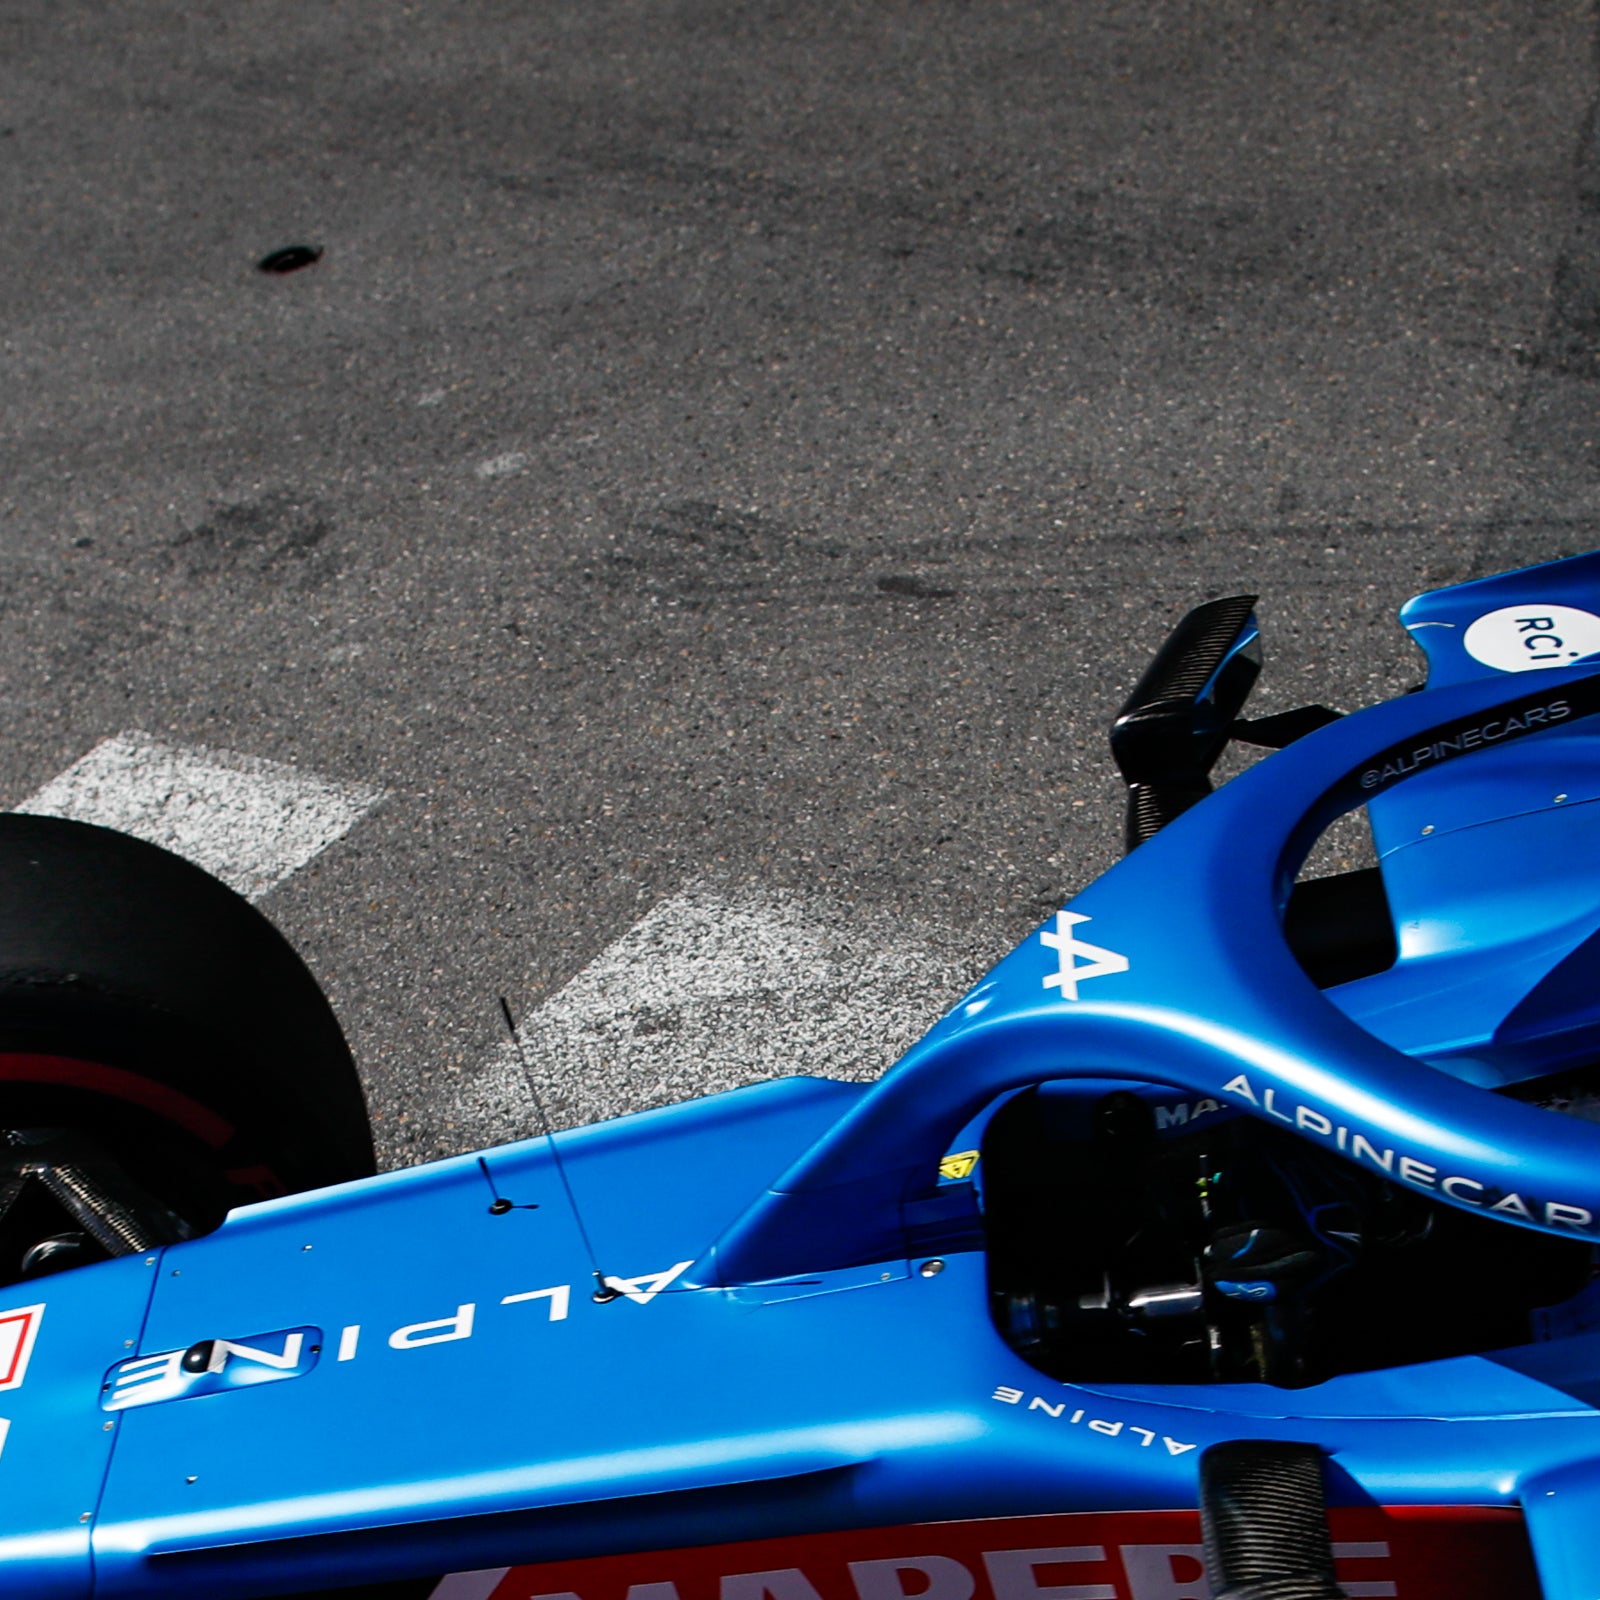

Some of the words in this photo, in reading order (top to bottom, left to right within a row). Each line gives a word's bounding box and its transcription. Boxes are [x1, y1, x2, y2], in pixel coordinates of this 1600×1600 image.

[1515, 616, 1580, 661] RCi
[1360, 699, 1571, 790] @ALPINECARS
[102, 1260, 693, 1413] ALPINE
[991, 1384, 1197, 1457] ALPINE
